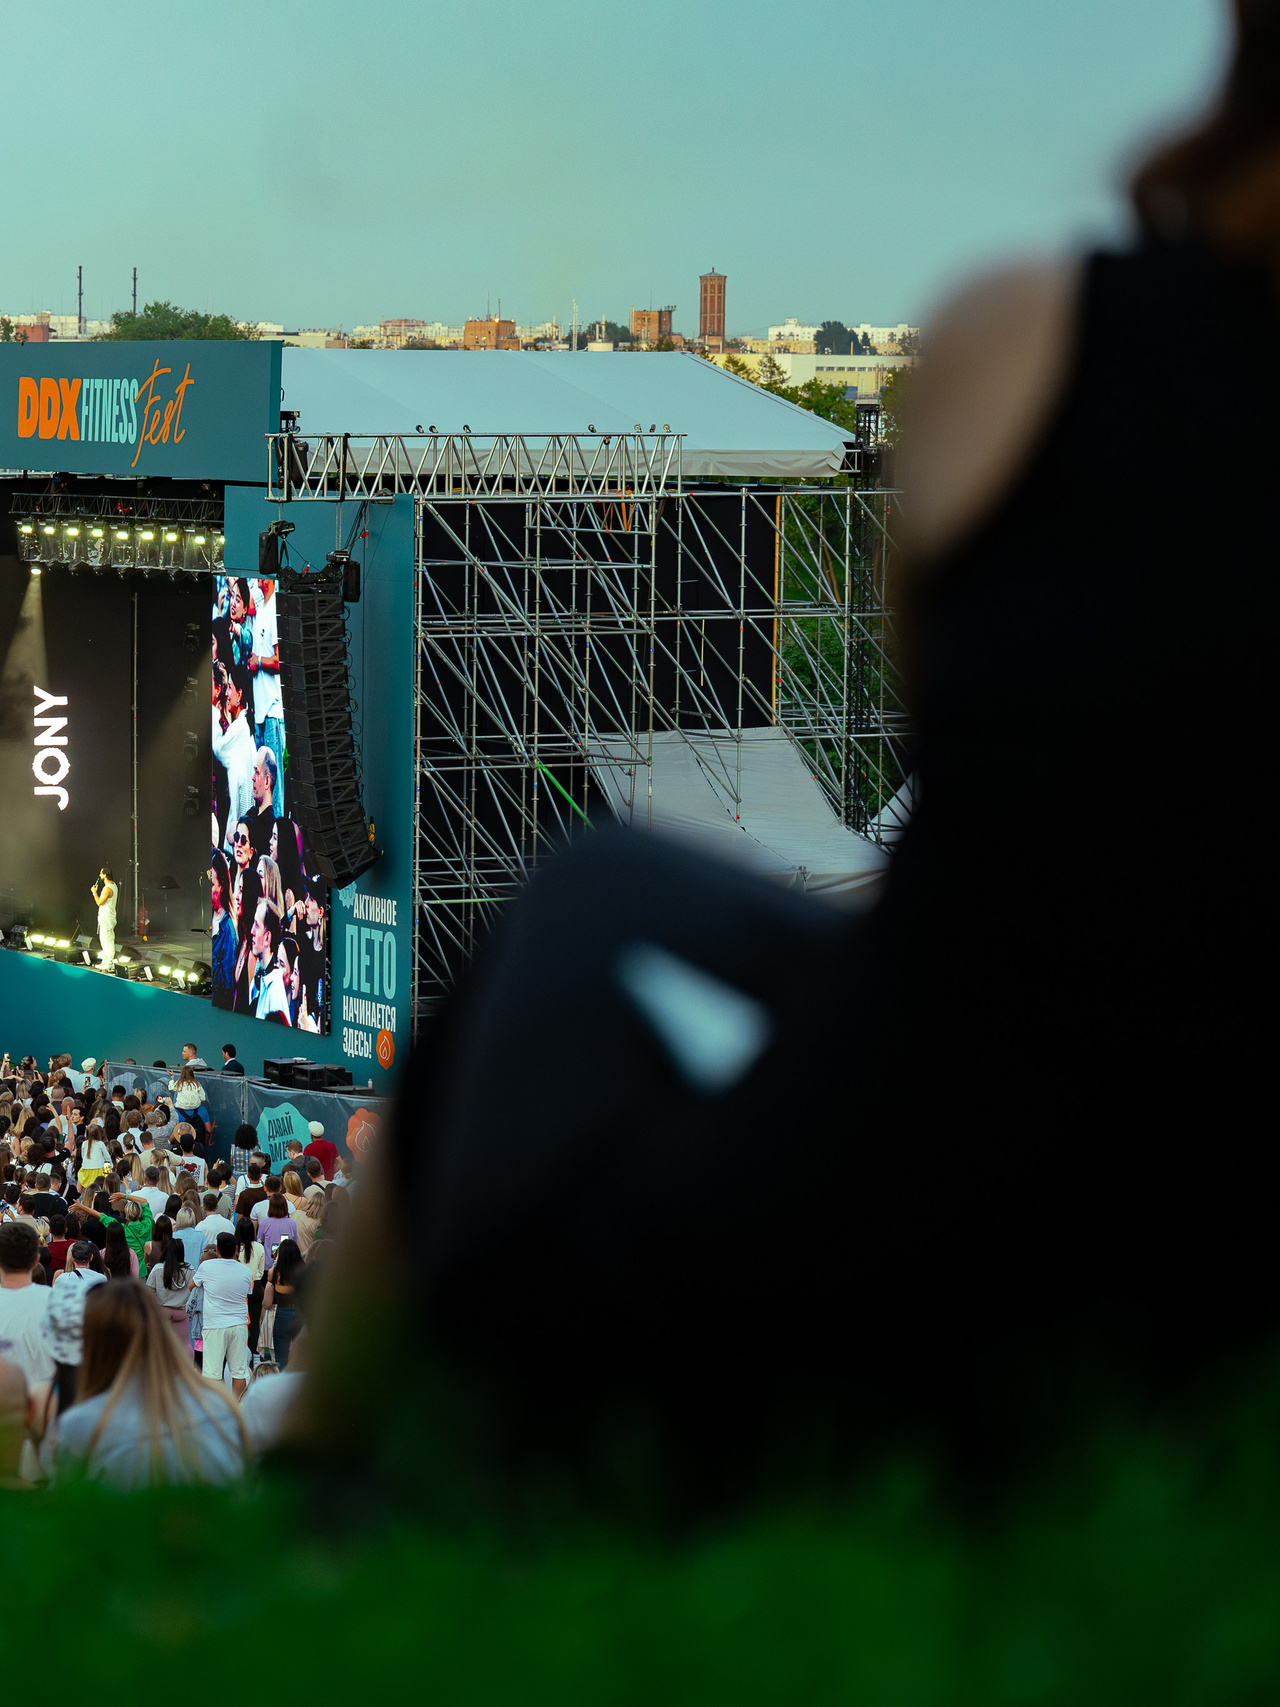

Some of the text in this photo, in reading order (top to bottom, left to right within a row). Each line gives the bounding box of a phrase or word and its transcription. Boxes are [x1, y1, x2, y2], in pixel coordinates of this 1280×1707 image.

[131, 358, 195, 468] Fest
[32, 685, 70, 811] JONY
[353, 892, 397, 926] АКТИВНОЕ
[342, 923, 397, 1000] ЛЕТО
[342, 994, 397, 1033] НАЧИНАЕТСЯ
[342, 1026, 372, 1060] ЗДЕСЬ!
[267, 1110, 295, 1142] ДАВАЙ
